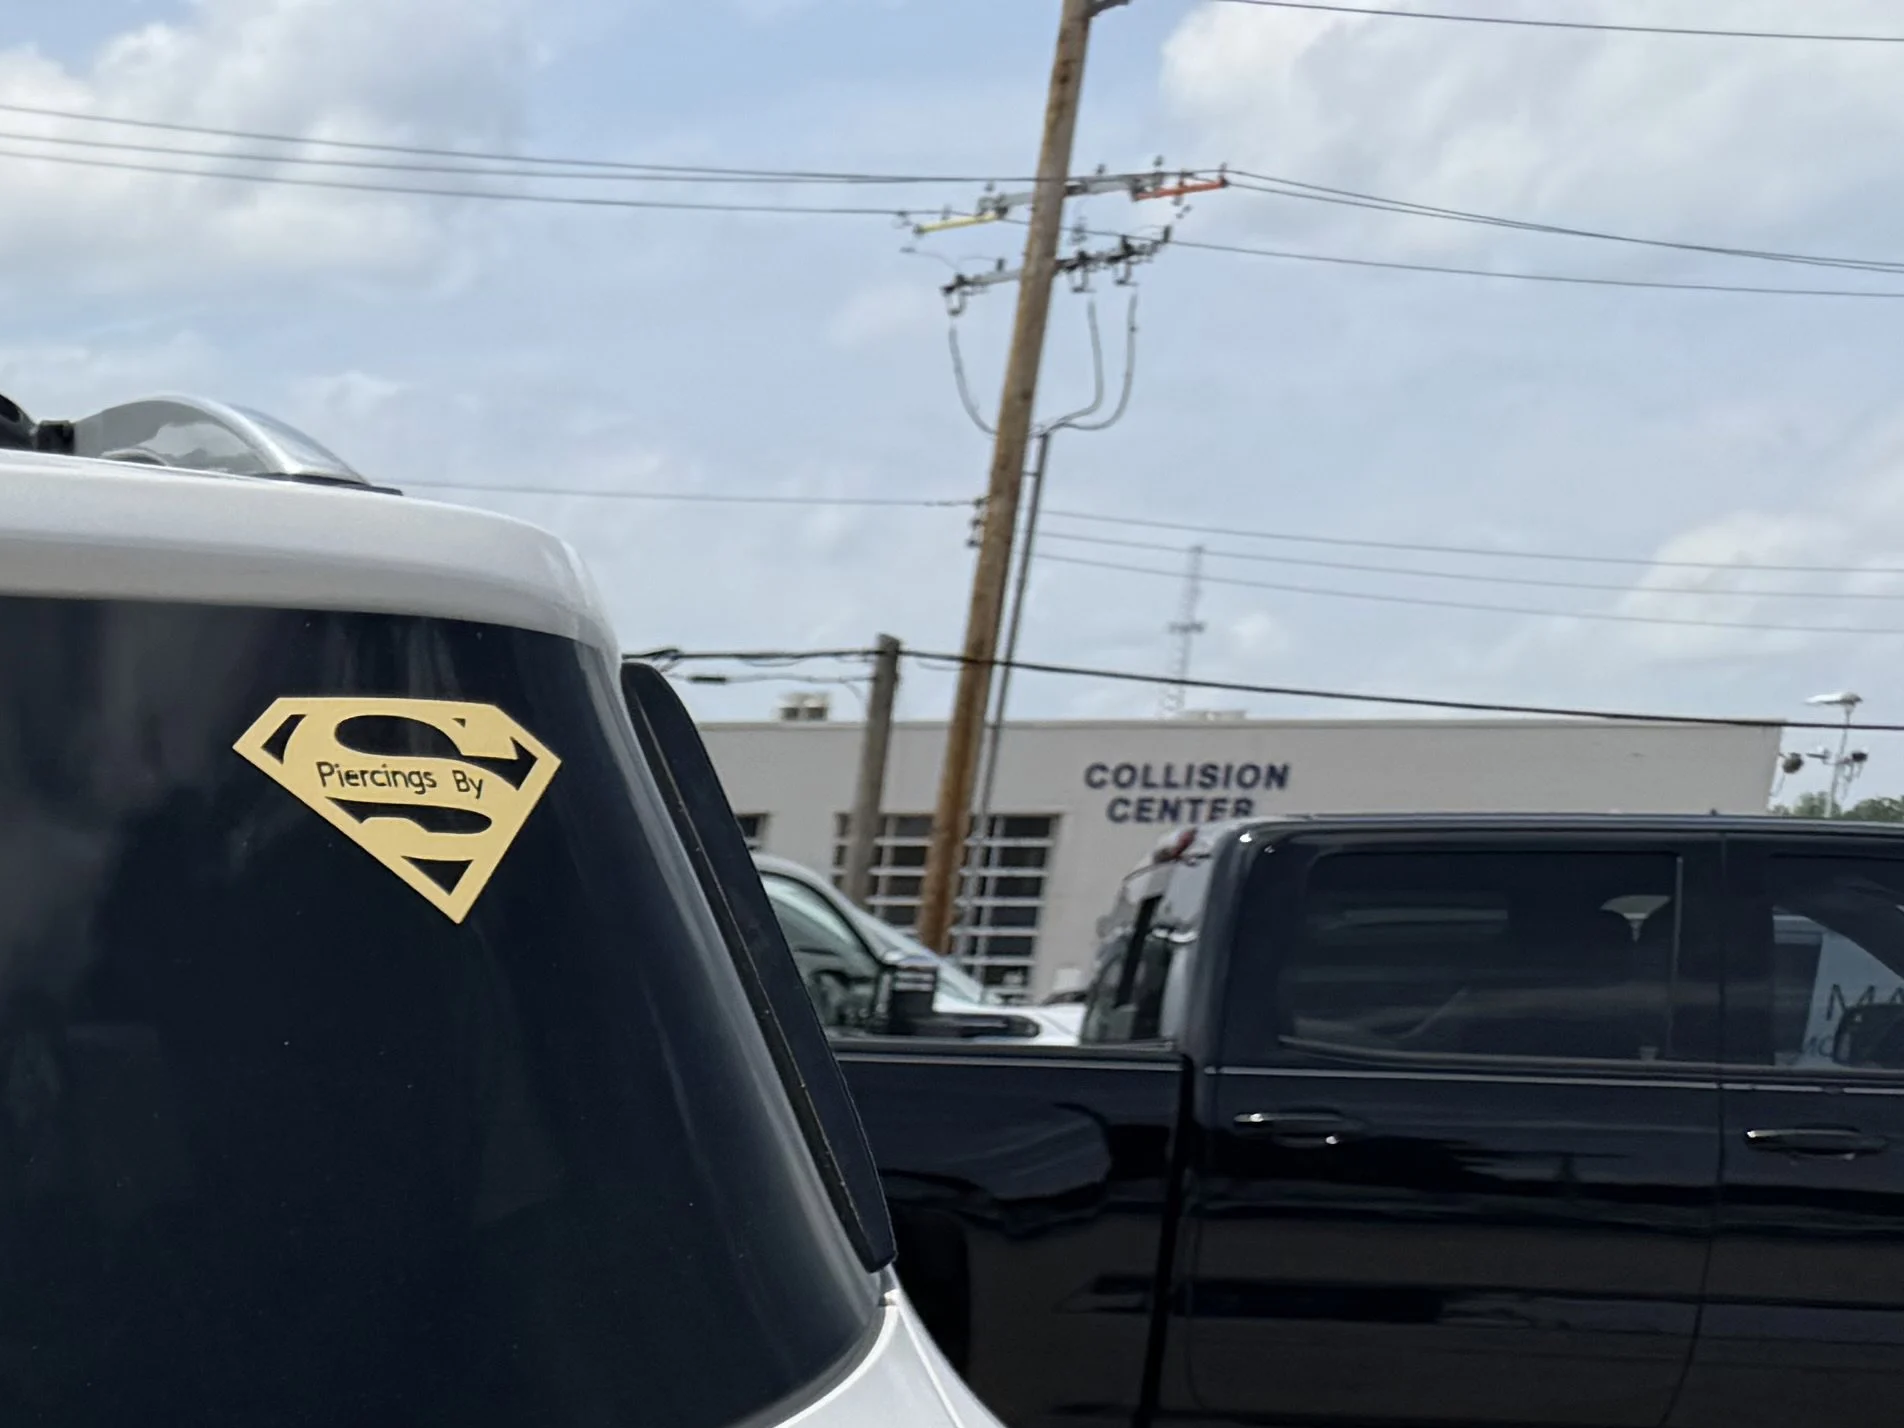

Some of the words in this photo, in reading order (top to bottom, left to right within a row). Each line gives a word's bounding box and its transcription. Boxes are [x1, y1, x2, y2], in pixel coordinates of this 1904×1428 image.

[315, 761, 437, 795] Piercings
[452, 769, 484, 799] By
[1084, 762, 1290, 789] COLLISION
[1106, 797, 1255, 823] CENTER
